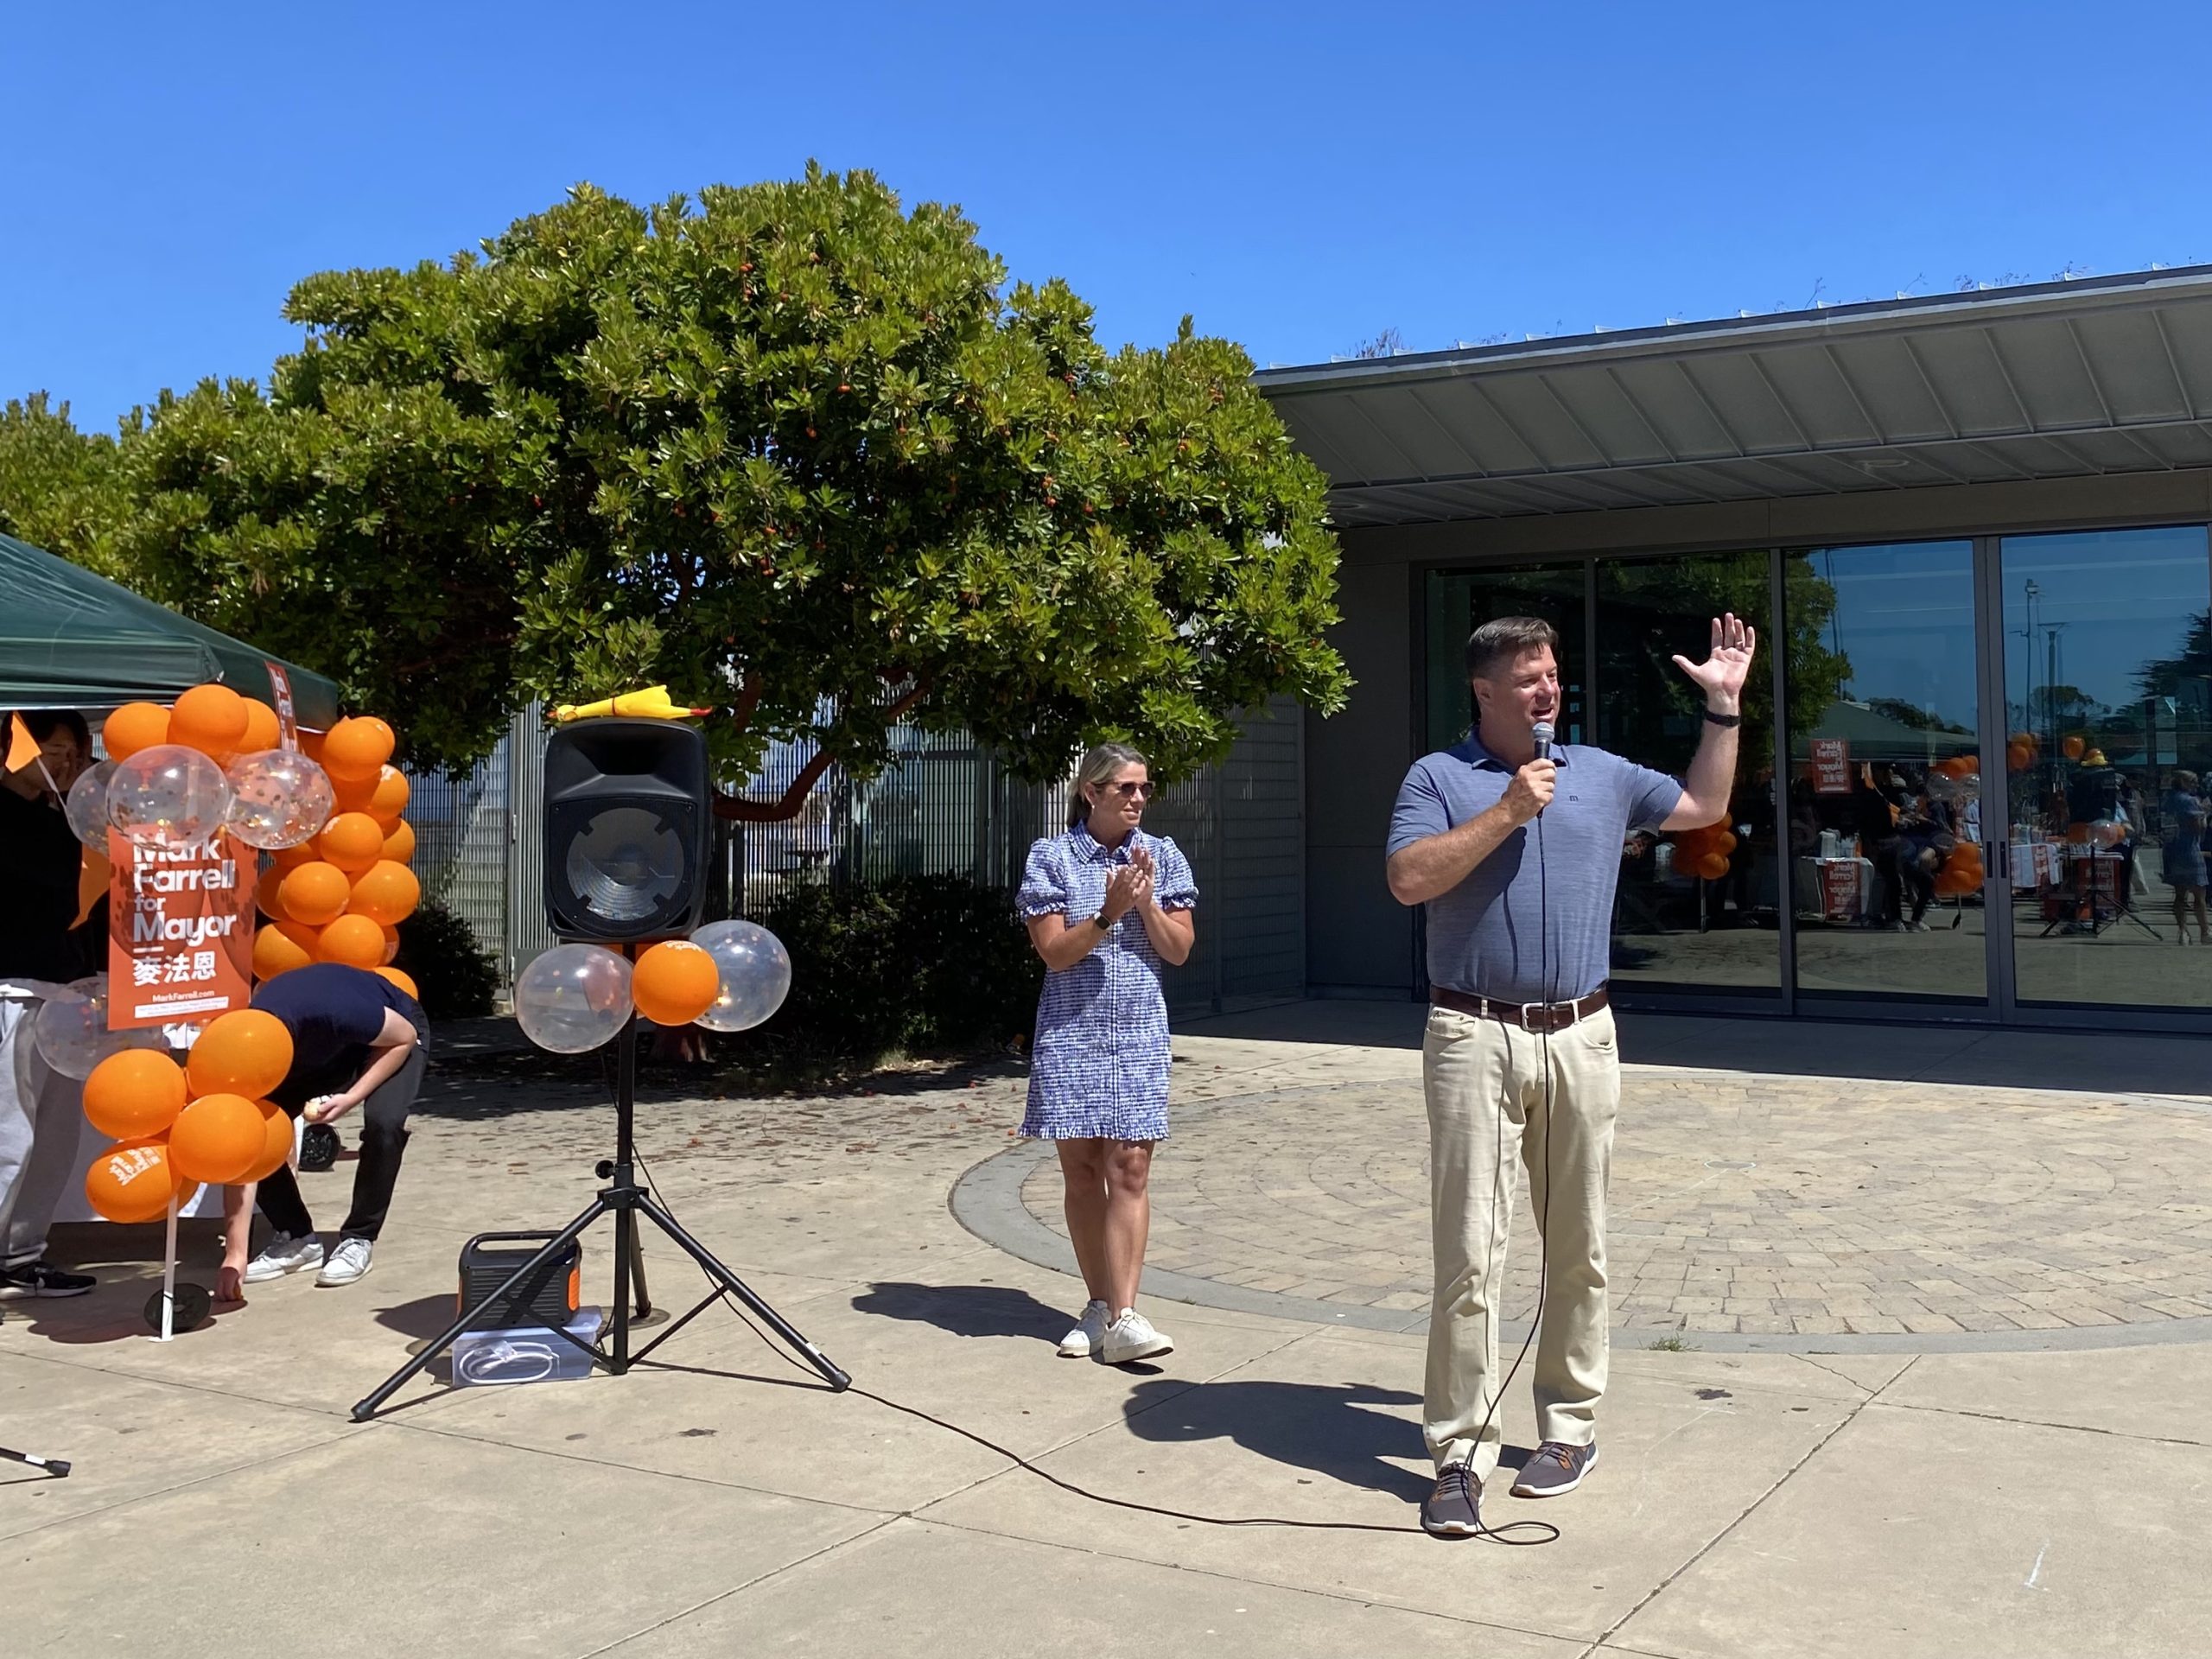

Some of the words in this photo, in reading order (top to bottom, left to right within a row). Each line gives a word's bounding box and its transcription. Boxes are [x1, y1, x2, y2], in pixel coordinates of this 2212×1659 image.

[133, 832, 220, 862] Mark
[133, 859, 236, 893] Farrell
[134, 893, 167, 912] for
[133, 911, 238, 947] Mayor
[132, 950, 216, 987] 麥法恩
[152, 990, 215, 1002] MarkFarrell.com
